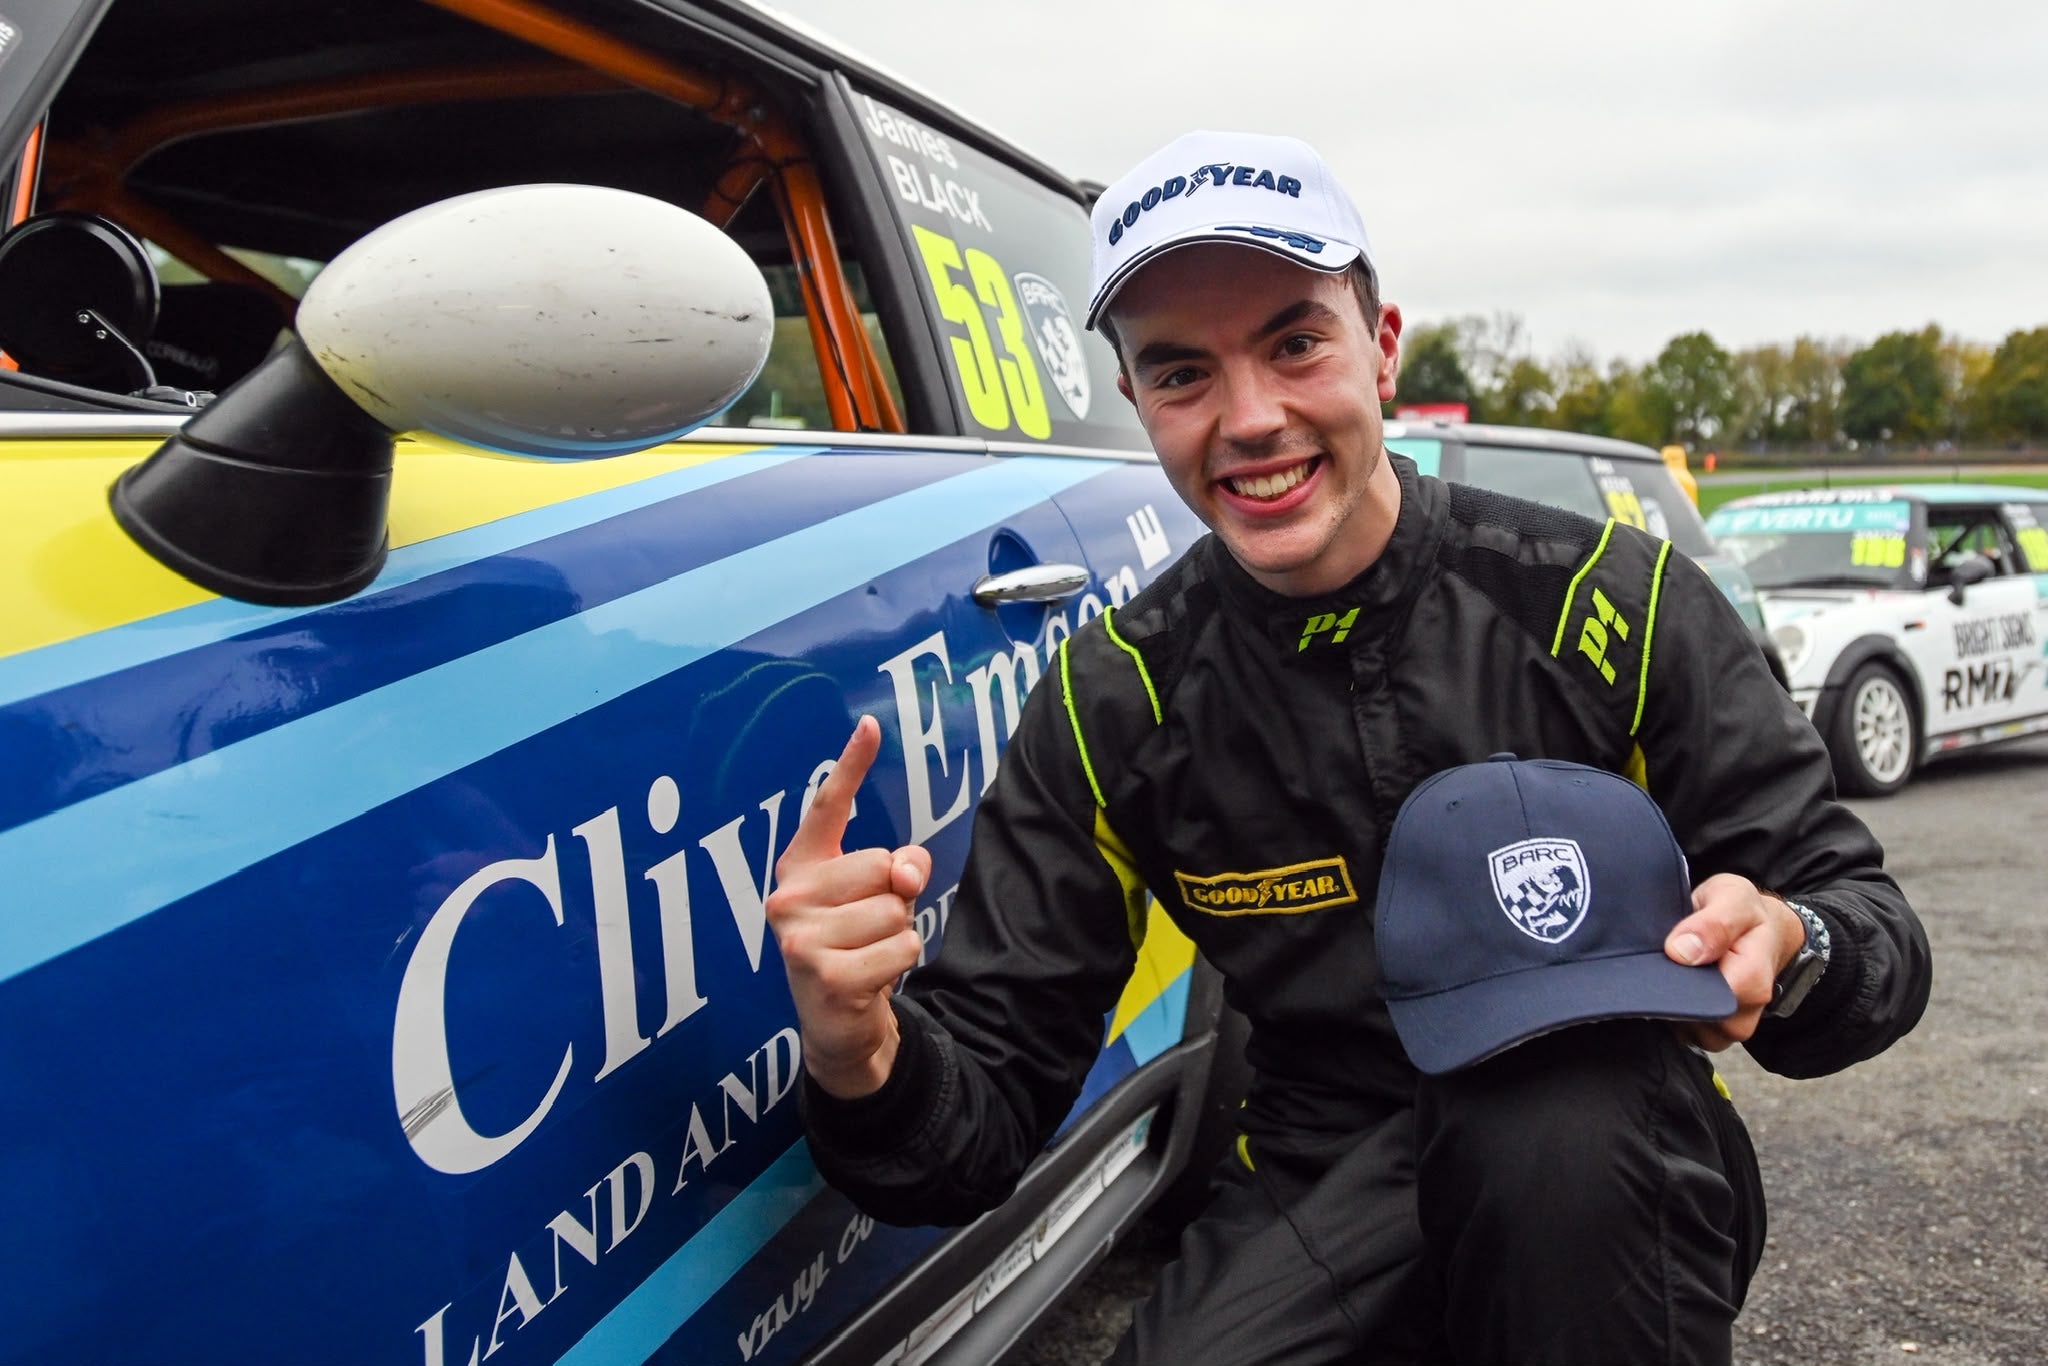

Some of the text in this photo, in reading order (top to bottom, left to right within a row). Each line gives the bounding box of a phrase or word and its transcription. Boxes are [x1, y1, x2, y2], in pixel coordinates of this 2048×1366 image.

[864, 95, 959, 170] James
[887, 156, 993, 233] BLACK
[911, 223, 1052, 440] 53
[1021, 281, 1066, 316] BARC
[1757, 506, 1855, 530] VERTU
[1298, 607, 1361, 652] P1
[1577, 587, 1630, 687] P1
[1502, 847, 1572, 874] BARC
[414, 1027, 801, 1366] LAND AND
